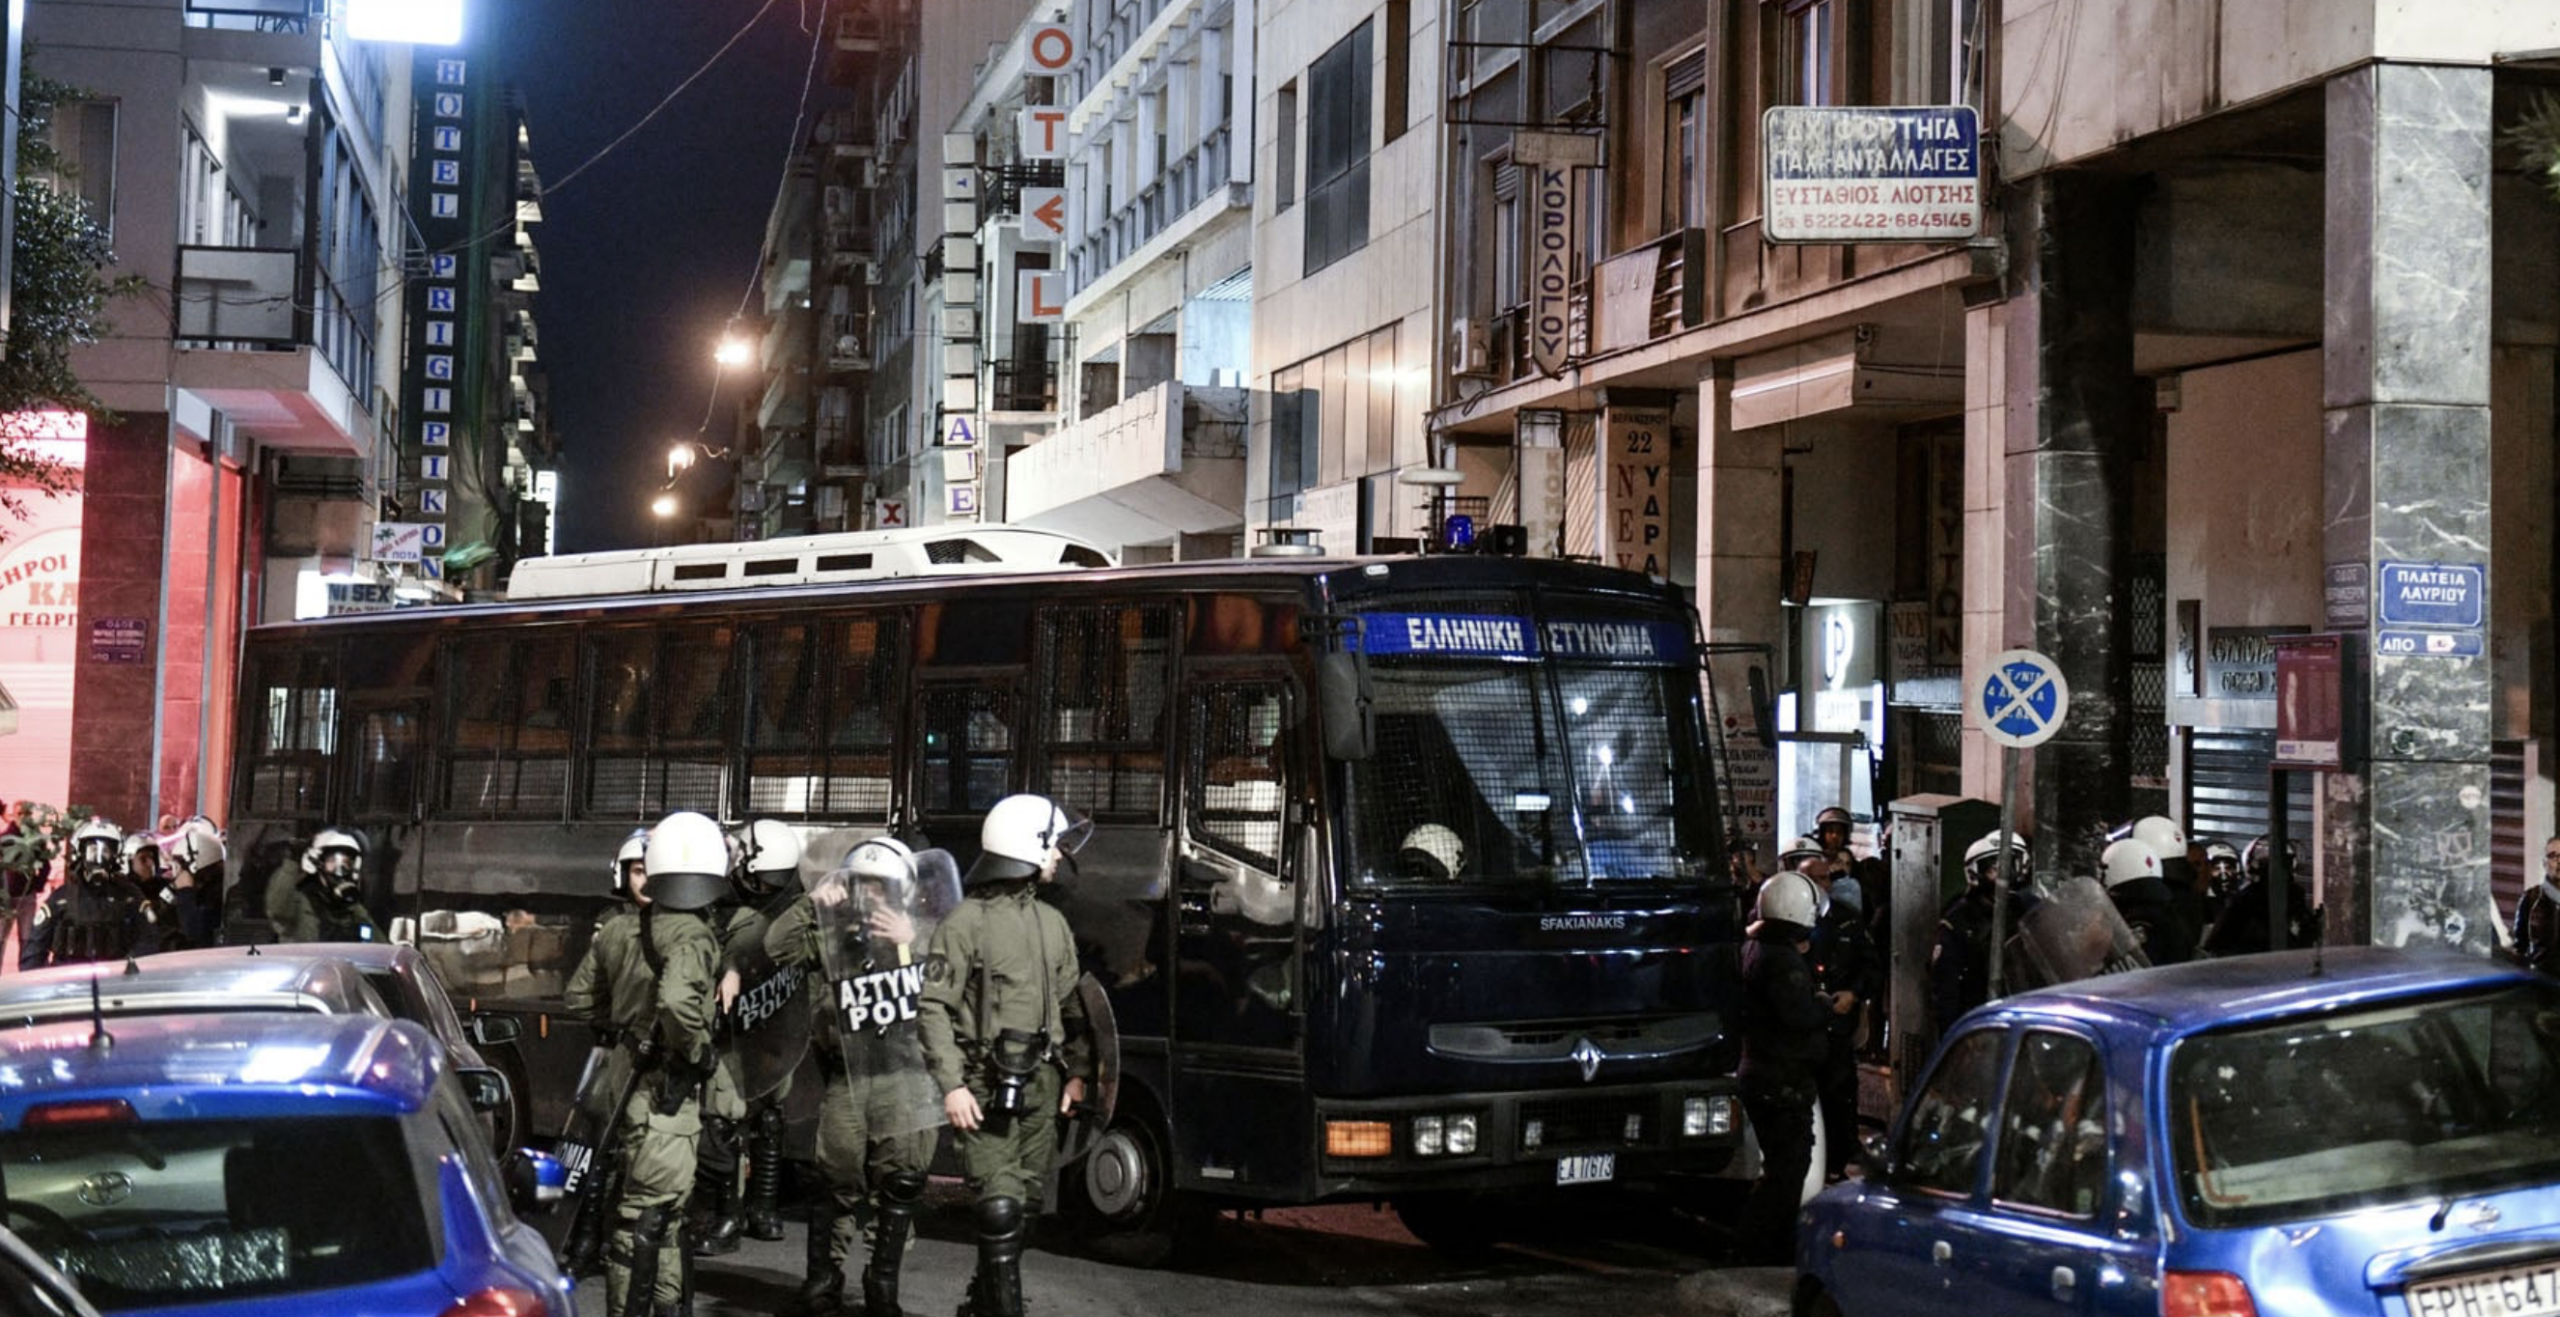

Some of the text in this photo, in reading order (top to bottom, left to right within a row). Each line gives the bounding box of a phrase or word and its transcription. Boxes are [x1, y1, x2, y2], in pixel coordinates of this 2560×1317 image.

[434, 61, 464, 218] HOTEL
[1835, 116, 1961, 142] ΦΟΡΤΗΓΑ
[1776, 185, 1975, 205] ΕΥΣΤΑΘΙΟΣ ΛΙΟΤΣΗΣ
[1538, 168, 1566, 357] ΚΟΡΟΛΟΓΟΥ
[423, 256, 455, 579] PRIGIPIKON
[1628, 430, 1653, 453] 22
[1643, 466, 1661, 575] ΥΔΡΑ
[0, 554, 67, 591] ΗΡΟΙ
[2397, 570, 2466, 586] ΠΛΑΤΕΙΑ
[352, 583, 391, 603] SEX
[2400, 586, 2467, 602] ΛΑΥΡΙΟΥ
[1406, 617, 1525, 652] ΕΛΛΗΝΙΚΗ
[2382, 637, 2415, 652] ΑΠΟ
[1540, 916, 1626, 930] SFAKIANAKIS
[743, 968, 803, 1032] POLIC
[849, 995, 918, 1032] POL
